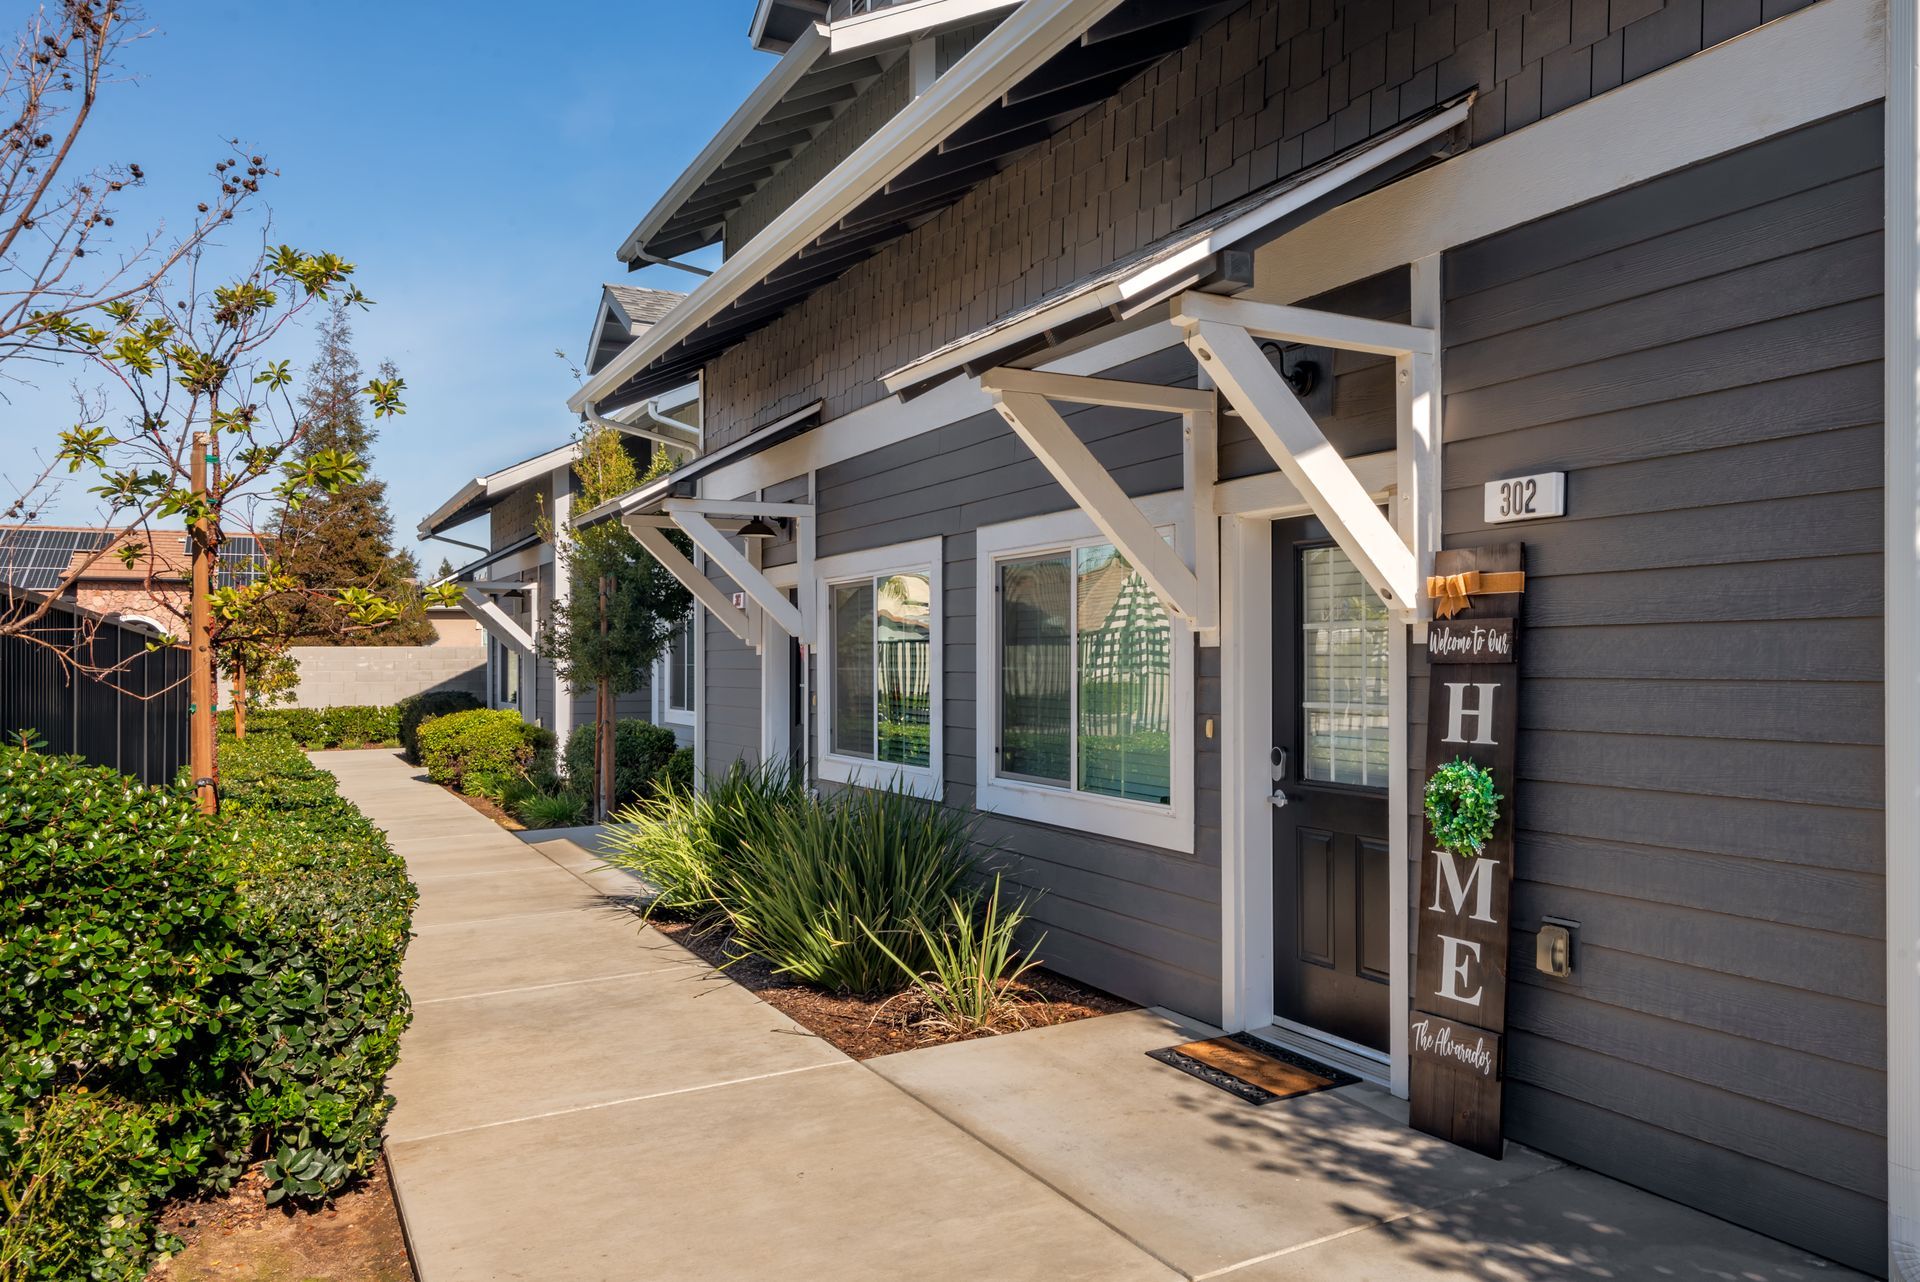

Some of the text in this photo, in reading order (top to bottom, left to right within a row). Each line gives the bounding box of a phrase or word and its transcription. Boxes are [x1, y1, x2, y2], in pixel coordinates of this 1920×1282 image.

[1500, 479, 1537, 517] 302
[1429, 625, 1509, 656] Welcome to Our
[1411, 1019, 1492, 1075] The Alvarados
